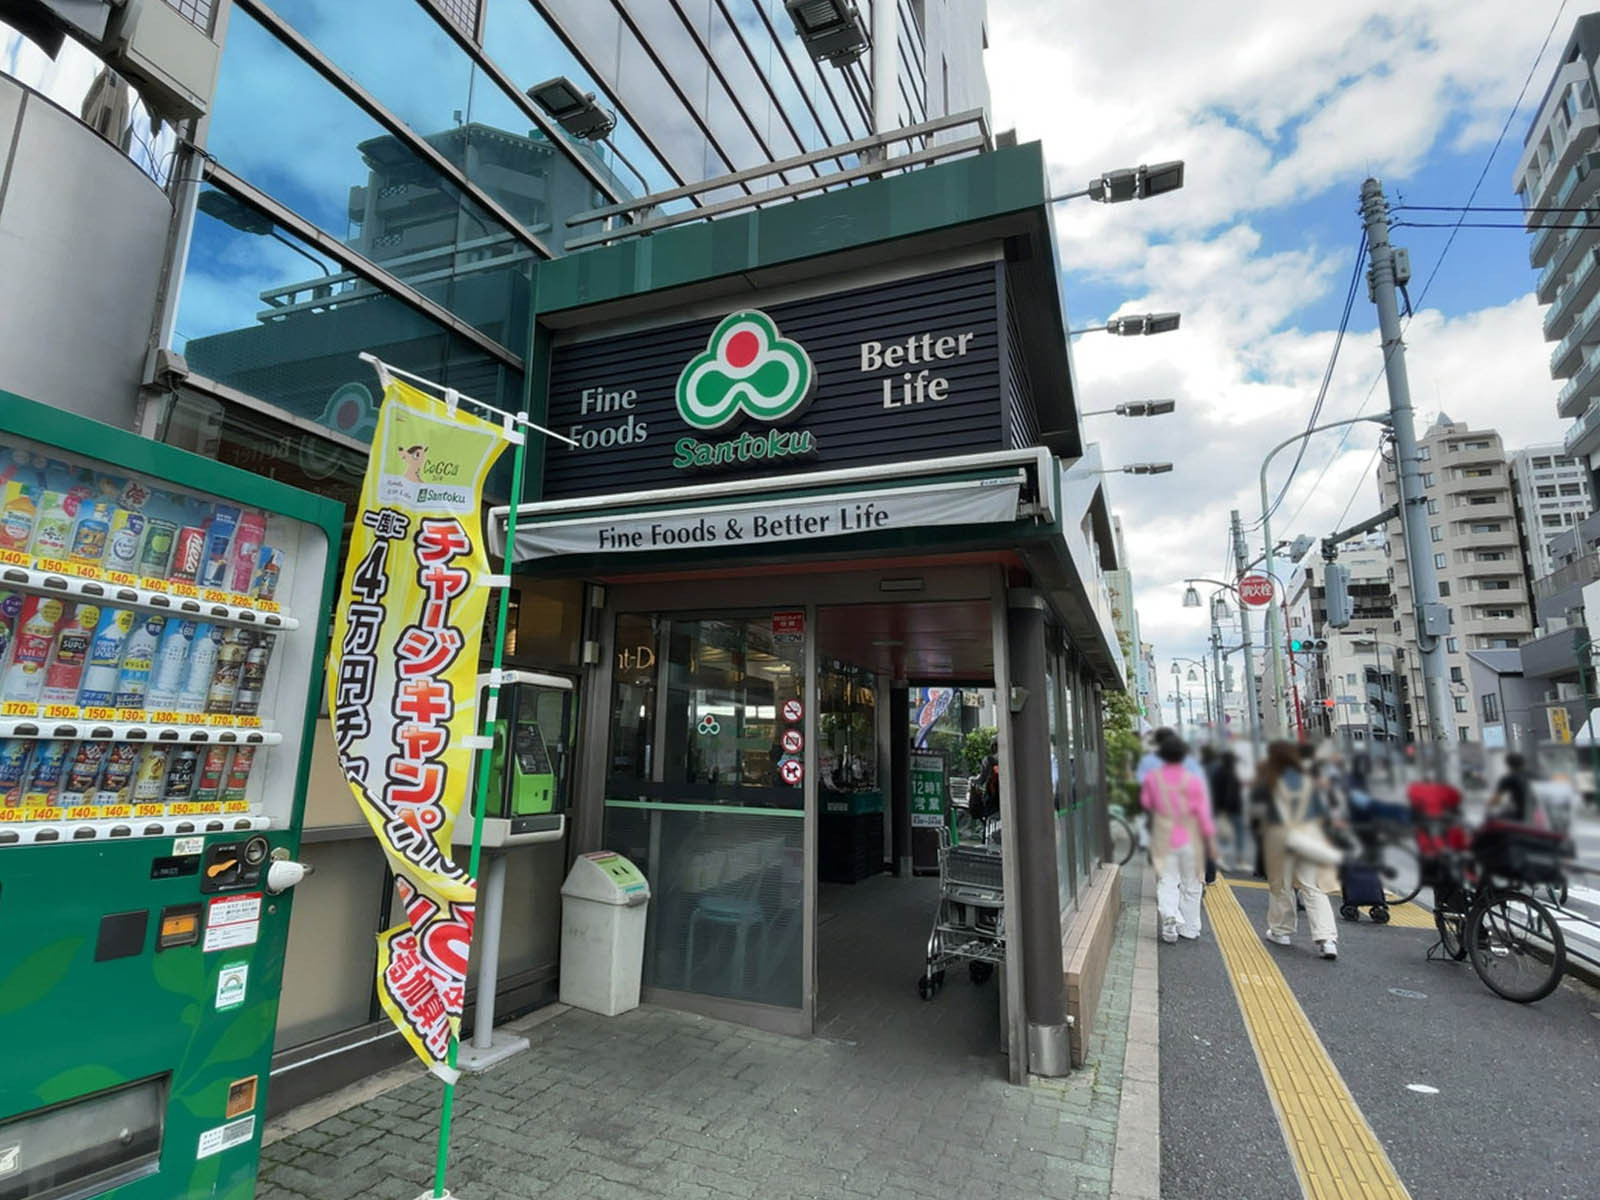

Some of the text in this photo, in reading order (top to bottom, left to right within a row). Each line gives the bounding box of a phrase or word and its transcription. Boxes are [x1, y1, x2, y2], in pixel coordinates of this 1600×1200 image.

[859, 331, 974, 374] Better
[579, 386, 638, 416] Fine
[881, 370, 950, 410] Life
[568, 414, 648, 452] Foods
[672, 427, 813, 469] Santoku
[427, 487, 466, 504] Santoku
[598, 504, 890, 550] Fine Foods & Better Life
[1240, 583, 1273, 598] 消火栓
